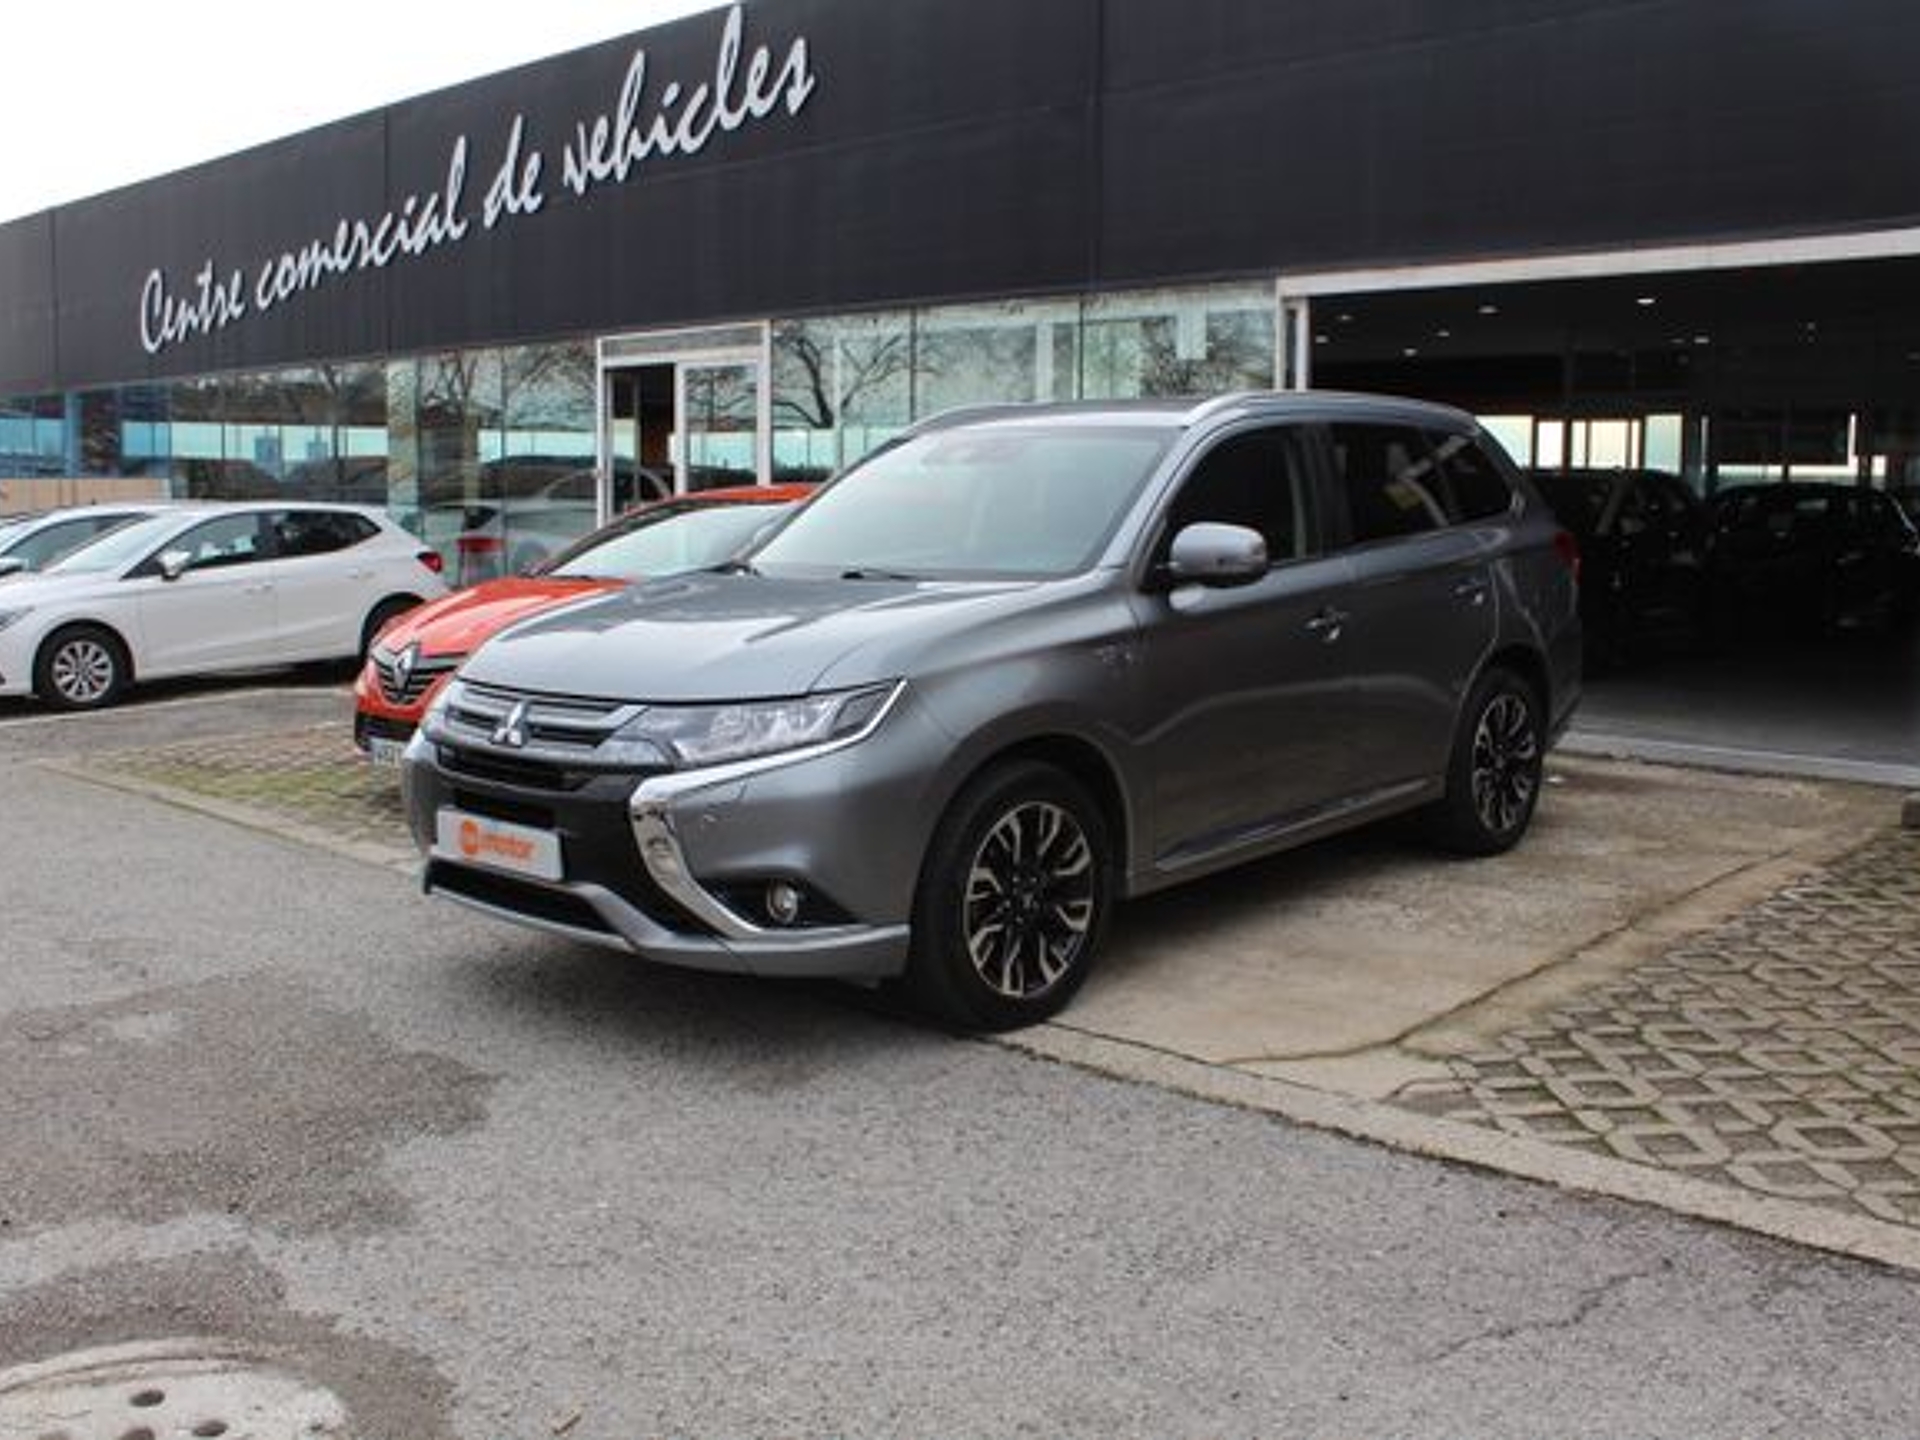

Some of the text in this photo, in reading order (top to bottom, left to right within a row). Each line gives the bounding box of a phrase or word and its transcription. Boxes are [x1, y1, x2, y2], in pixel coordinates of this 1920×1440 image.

[140, 4, 815, 353] Centre comercial de vehicles
